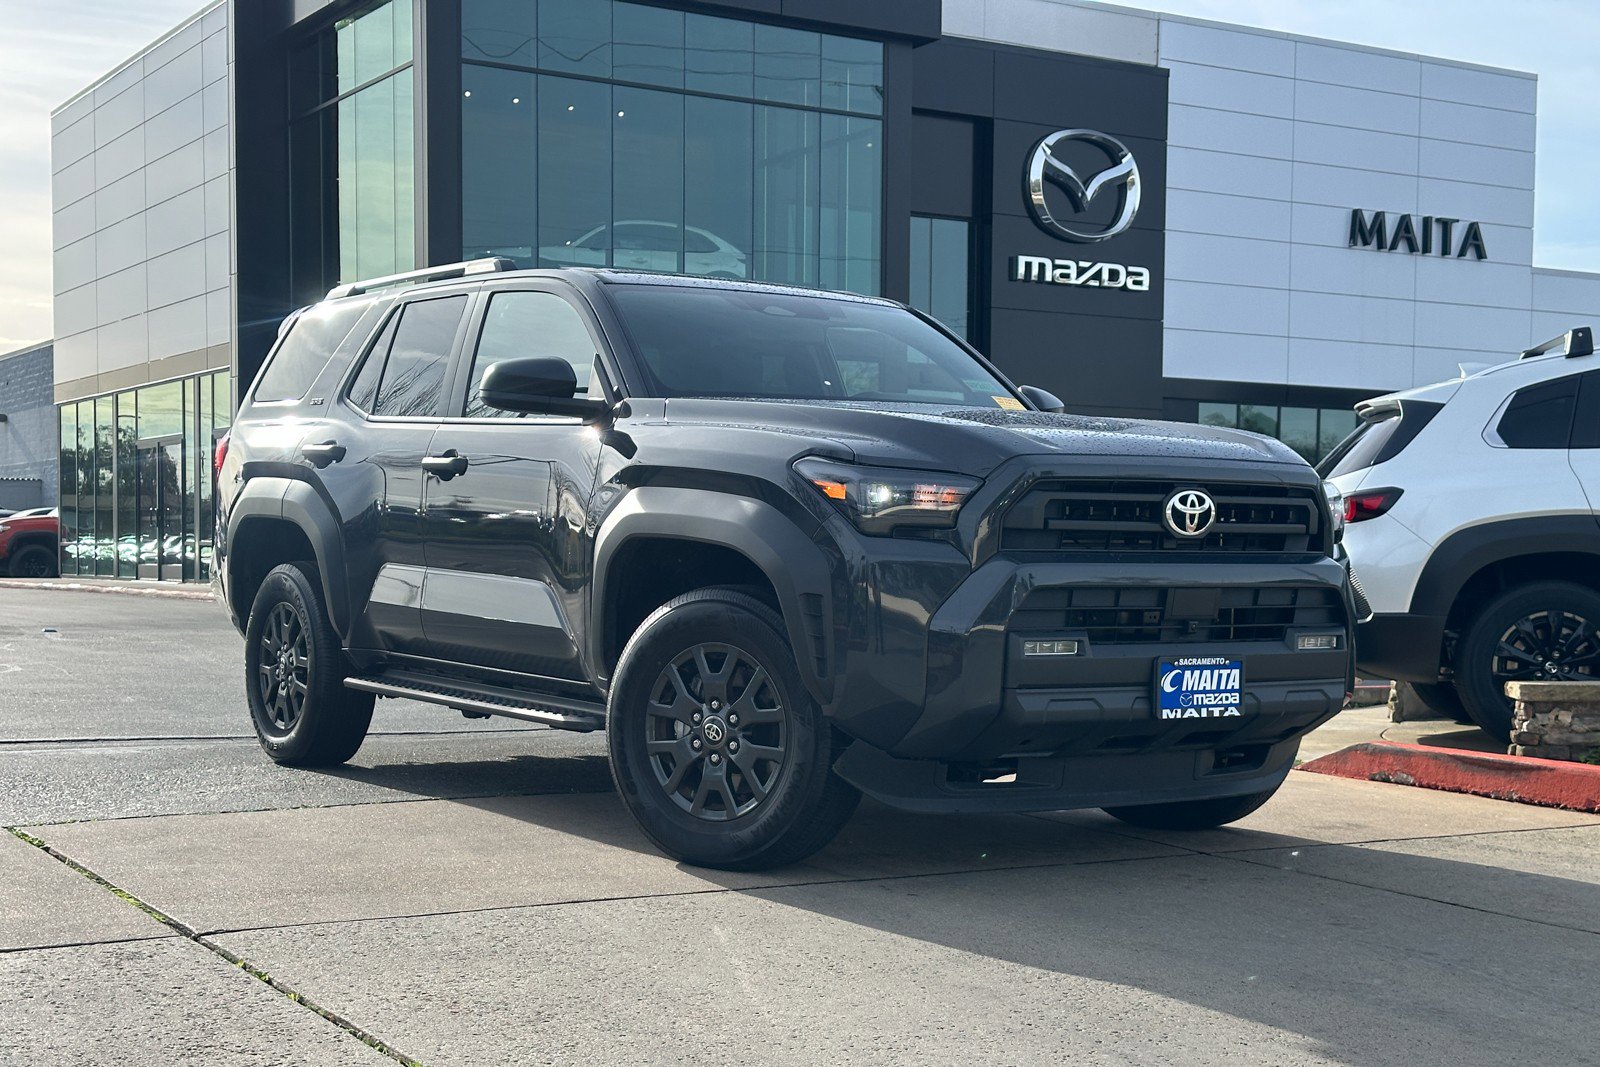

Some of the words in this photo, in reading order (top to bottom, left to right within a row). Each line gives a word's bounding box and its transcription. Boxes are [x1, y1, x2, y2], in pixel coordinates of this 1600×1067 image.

[1349, 208, 1487, 259] MAITA
[1179, 658, 1225, 666] SACRAMENTO
[1181, 669, 1240, 691] MAITA
[1162, 707, 1241, 719] MAITA
